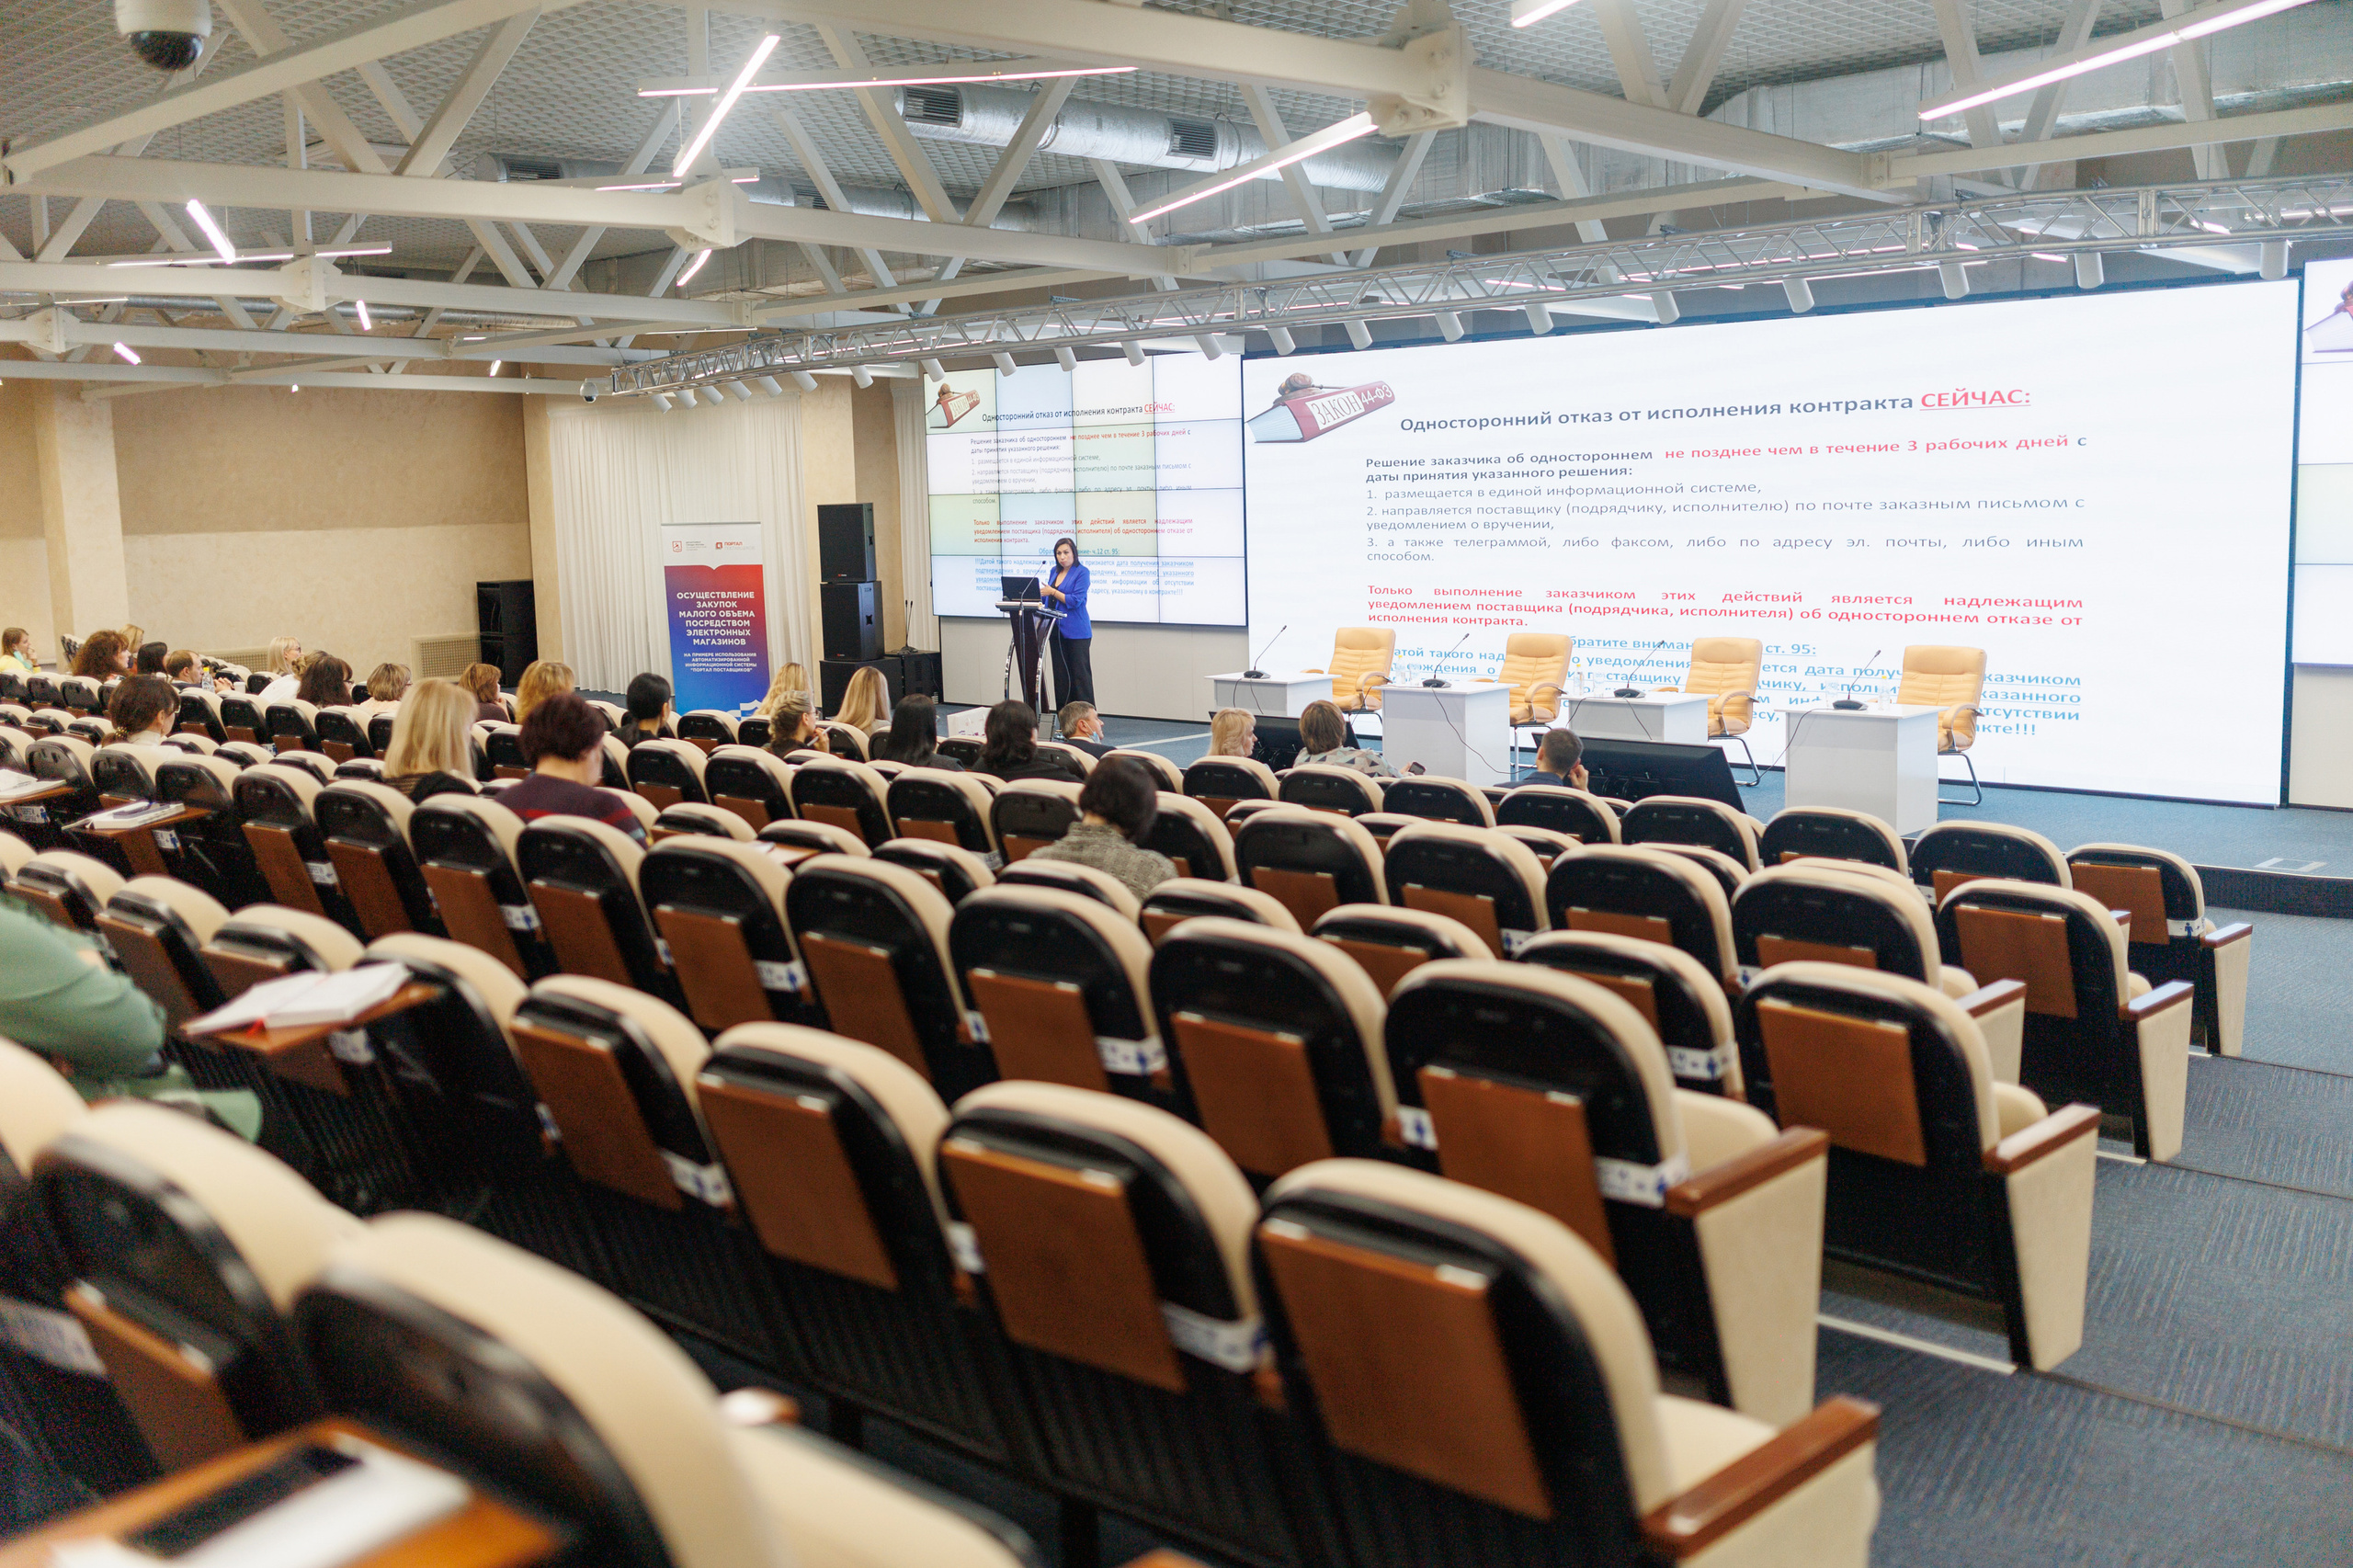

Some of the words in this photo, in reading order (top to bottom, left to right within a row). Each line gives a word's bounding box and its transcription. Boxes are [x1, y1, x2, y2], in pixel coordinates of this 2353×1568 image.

[982, 411, 1035, 423] Односторонний
[1035, 411, 1053, 419] отказ
[1063, 409, 1105, 417] исполнения
[1107, 405, 1143, 415] контракта
[1143, 402, 1176, 414] СЕЙЧАС:
[1311, 393, 1362, 425] ЗАКОН
[1360, 385, 1392, 405] 44-ФЗ
[1400, 410, 1552, 434] Односторонний
[1558, 412, 1613, 425] отказ
[1619, 410, 1642, 422] от
[1647, 403, 1781, 420] исполнения
[1790, 397, 1913, 415] контракта
[1920, 387, 2030, 409] СЕЙЧАС:
[1366, 458, 1426, 468] Решение
[1430, 456, 1501, 466] заказчика
[1506, 452, 1525, 464] об
[1529, 450, 1653, 465] одностороннем
[1665, 449, 1685, 459] не
[1691, 448, 1761, 460] позднее
[1768, 446, 1802, 456] чем
[1810, 445, 1819, 455] в
[1825, 443, 1900, 454] течение
[1907, 439, 1917, 451] 3
[1926, 437, 2007, 453] рабочих
[2016, 435, 2068, 450] дней
[2077, 437, 2086, 447] с
[1366, 473, 1399, 484] даты
[1403, 472, 1468, 483] принятия
[1472, 469, 1555, 482] указанного
[1559, 467, 1632, 480] решения:
[1367, 489, 1377, 499] 1.
[1385, 489, 1472, 501] размещается
[1477, 489, 1485, 497] в
[1488, 485, 1541, 499] единой
[1547, 482, 1684, 498] информационной
[1690, 483, 1761, 494] системе,
[1367, 506, 1377, 517] 2.
[1381, 506, 1472, 517] направляется
[1476, 506, 1562, 517] поставщику
[1566, 502, 1666, 516] (подрядчику,
[1673, 499, 1789, 514] исполнителю)
[1795, 502, 1816, 511] по
[1823, 501, 1873, 511] почте
[1879, 500, 1971, 510] заказным
[1978, 498, 2068, 509] письмом
[2075, 498, 2085, 508] с
[1366, 521, 1467, 532] уведомлением
[1471, 521, 1480, 529] о
[1483, 520, 1554, 531] вручении,
[1368, 537, 1378, 547] 3.
[1387, 539, 1394, 547] а
[1404, 539, 1444, 548] также
[1453, 536, 1551, 550] телеграммой,
[1563, 536, 1599, 548] либо
[1610, 536, 1673, 550] факсом,
[1686, 535, 1726, 548] либо
[1740, 539, 1760, 548] по
[1772, 539, 1833, 550] адресу
[1847, 538, 1870, 548] эл.
[1886, 538, 1947, 550] почты,
[1961, 535, 2010, 548] либо
[2027, 539, 2084, 548] иным
[1367, 550, 1434, 562] способом.
[1368, 585, 1413, 596] Только
[1434, 587, 1522, 597] выполнение
[1546, 590, 1636, 599] заказчиком
[1661, 592, 1696, 601] этих
[1722, 590, 1802, 604] действий
[1831, 595, 1913, 605] является
[1944, 597, 2083, 610] надлежащим
[1368, 600, 1472, 611] уведомлением
[1476, 603, 1563, 615] поставщика
[1568, 602, 1674, 618] (подрядчика,
[1680, 607, 1793, 621] исполнителя)
[1800, 608, 1822, 619] об
[1828, 610, 1979, 624] одностороннем
[1987, 614, 2053, 625] отказе
[2061, 617, 2083, 626] от
[1368, 614, 1448, 624] исполнения
[1452, 616, 1528, 628] контракта.
[1570, 636, 1628, 648] братите
[1632, 641, 1693, 650] вниман
[1765, 644, 1785, 653] ст.
[1790, 643, 1816, 654] 95:
[1393, 647, 1424, 656] атой
[1428, 651, 1473, 660] такого
[1586, 656, 1691, 669] уведомления
[1804, 666, 1844, 676] дата
[1853, 668, 1903, 680] получ
[1984, 674, 2081, 686] казчиком
[1586, 672, 1682, 686] пставщику
[1980, 690, 2081, 704] казанного
